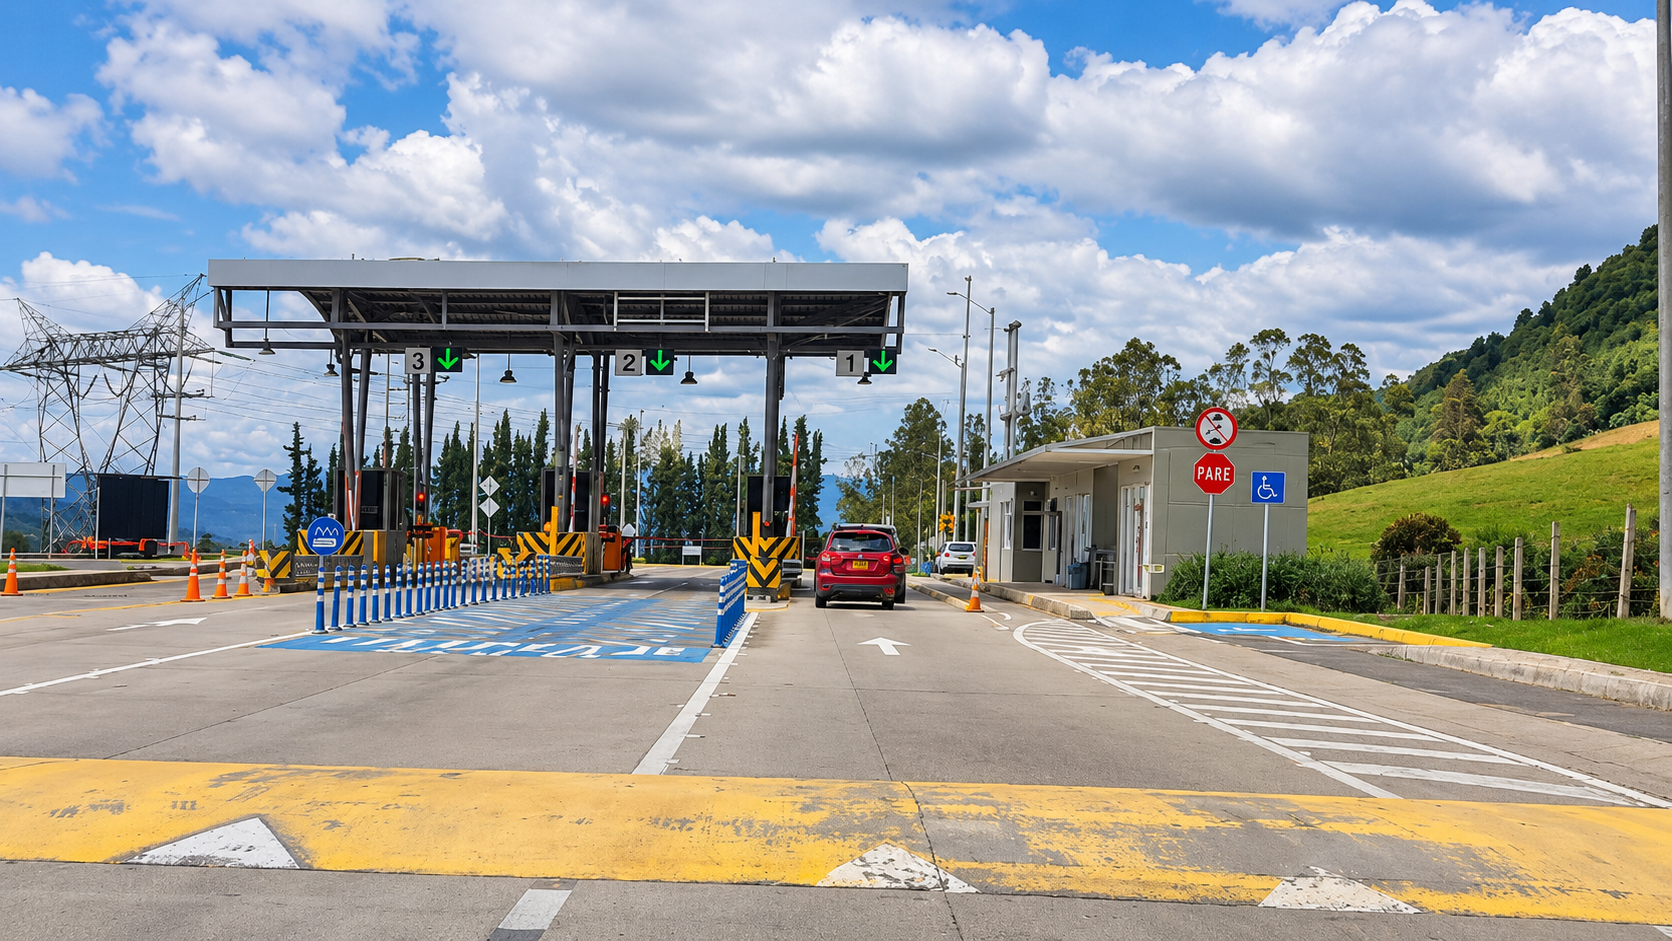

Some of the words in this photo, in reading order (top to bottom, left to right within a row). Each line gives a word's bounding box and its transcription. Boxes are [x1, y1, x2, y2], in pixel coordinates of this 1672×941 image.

[412, 352, 424, 370] 3
[623, 353, 636, 372] 2
[846, 354, 854, 372] 1
[1197, 466, 1231, 481] PARE
